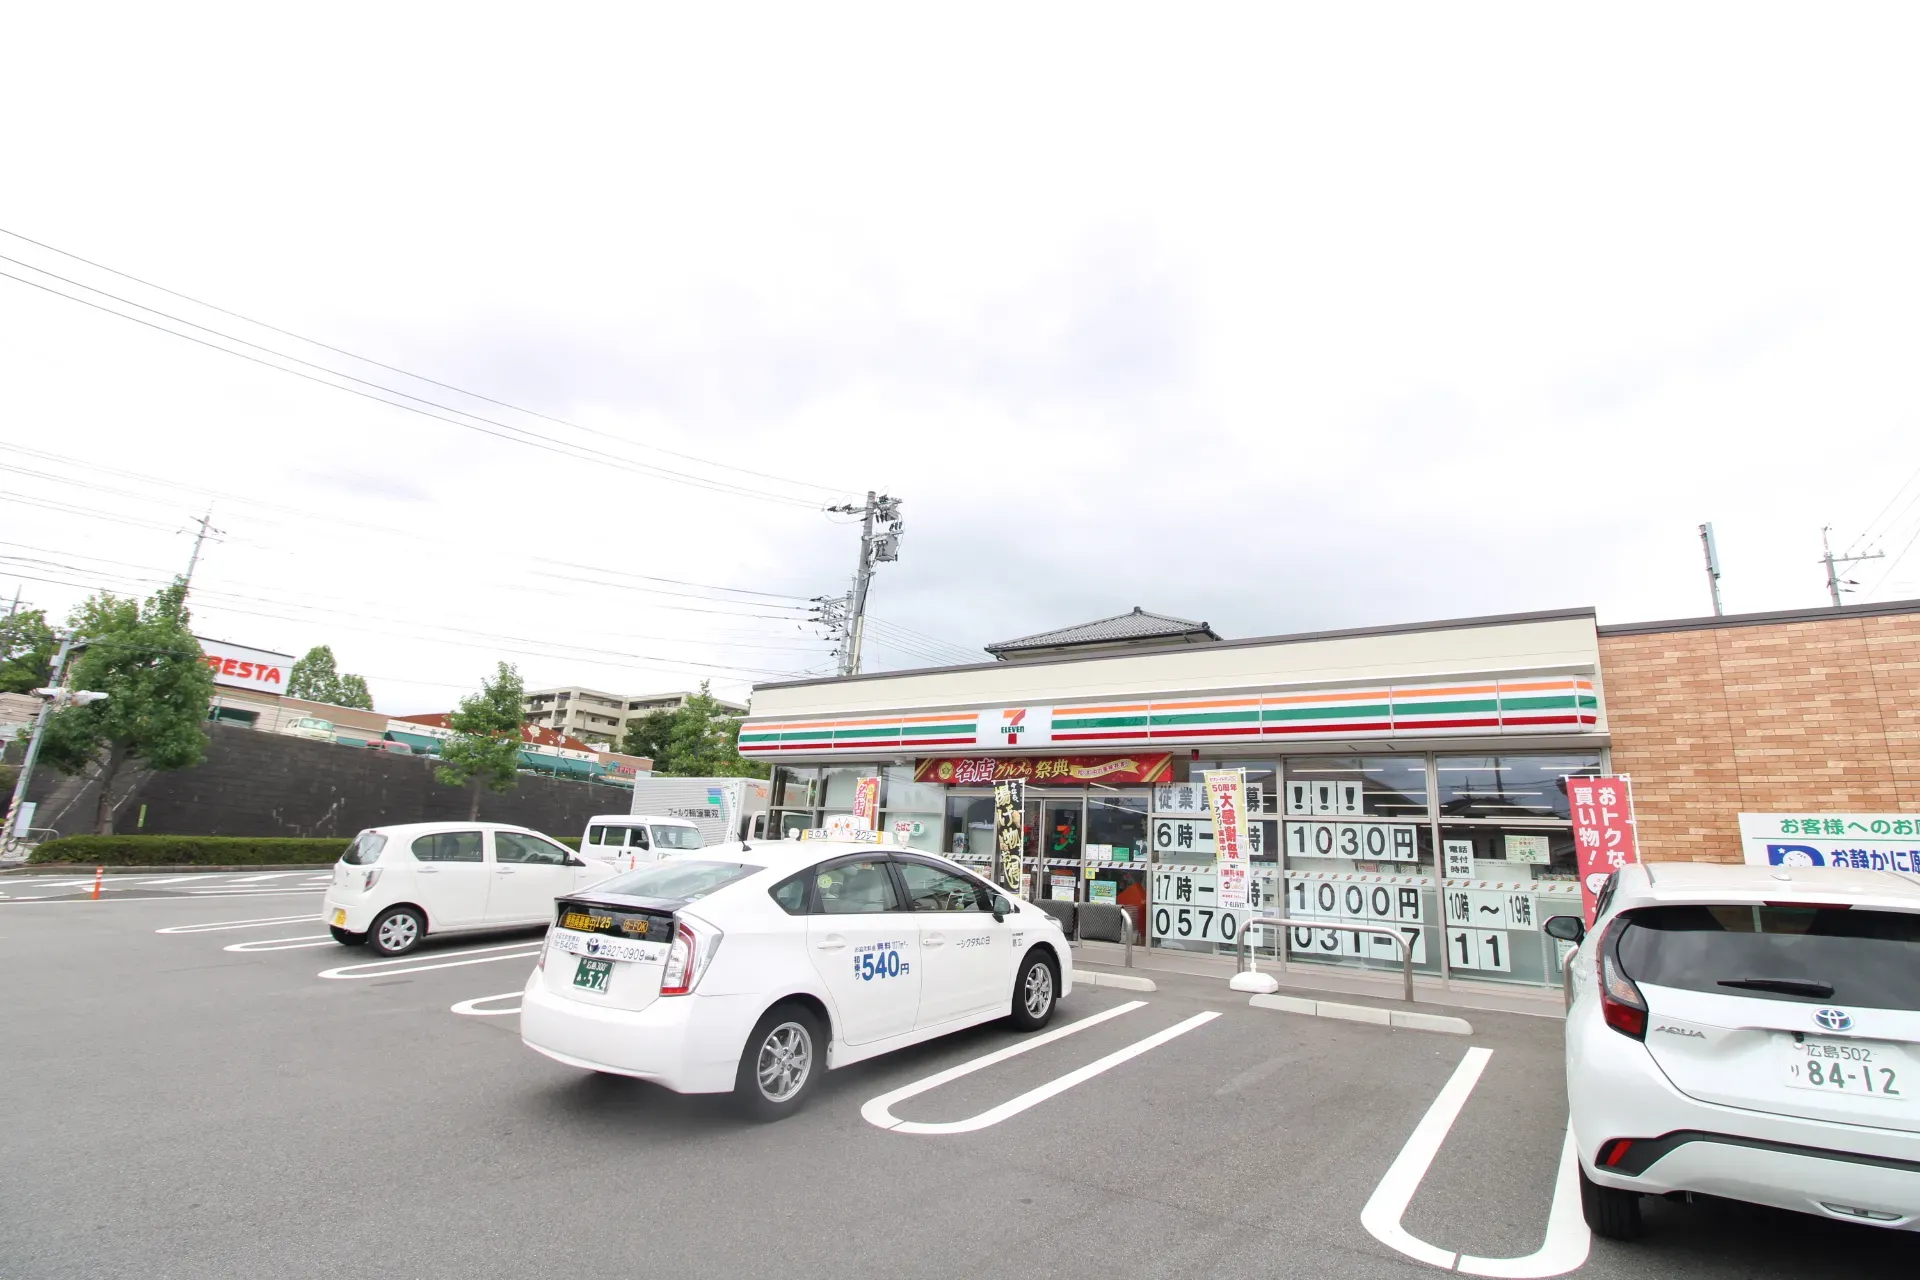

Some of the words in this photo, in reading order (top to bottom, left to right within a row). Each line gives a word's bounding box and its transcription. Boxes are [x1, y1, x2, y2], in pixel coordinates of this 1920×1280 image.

[1212, 783, 1238, 792] 50周年
[807, 829, 828, 839] 日の丸
[855, 830, 877, 840] タクシー
[895, 823, 911, 832] たばこ
[1220, 792, 1239, 859] 大感謝祭
[1598, 787, 1627, 868] おトクな
[1293, 826, 1414, 859] 1030円
[1449, 845, 1468, 854] 電話
[1450, 855, 1468, 864] 受付
[1450, 865, 1470, 874] 時間
[1293, 882, 1419, 920] 1000円
[607, 944, 645, 961] 927-0909
[1455, 932, 1501, 967] 11
[861, 950, 910, 982] 540円
[1653, 1025, 1707, 1040] AQUA
[1806, 1043, 1874, 1063] 広島502
[1806, 1060, 1900, 1095] 84-12
